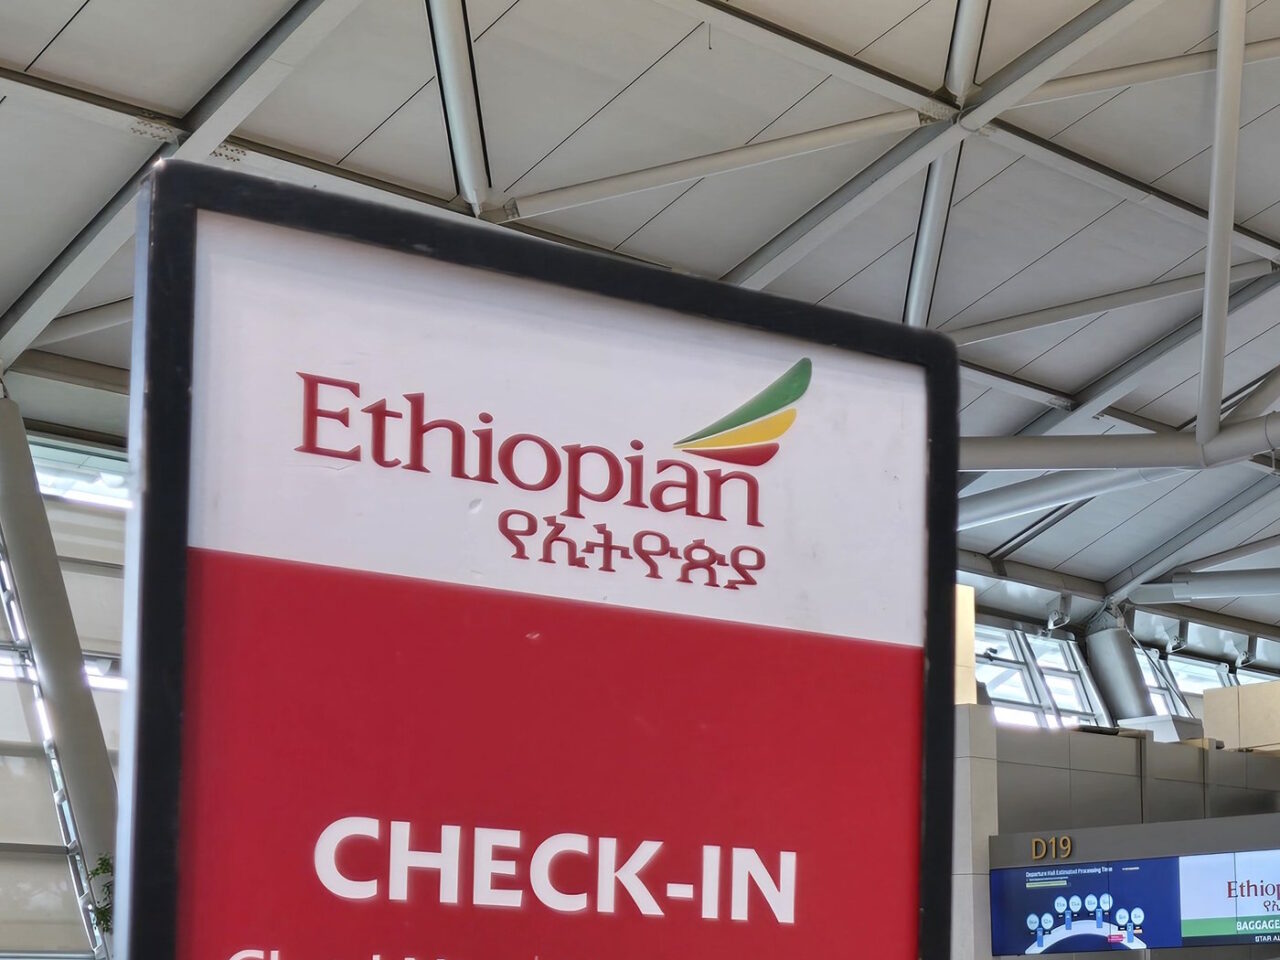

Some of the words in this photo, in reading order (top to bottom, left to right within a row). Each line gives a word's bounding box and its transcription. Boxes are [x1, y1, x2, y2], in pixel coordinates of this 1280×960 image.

[294, 371, 766, 528] Ethiopian
[497, 508, 767, 591] የኢትዮጵያ
[314, 816, 797, 925] CHECK-IN
[1031, 835, 1072, 861] D19
[1236, 919, 1280, 931] BAGGAGE
